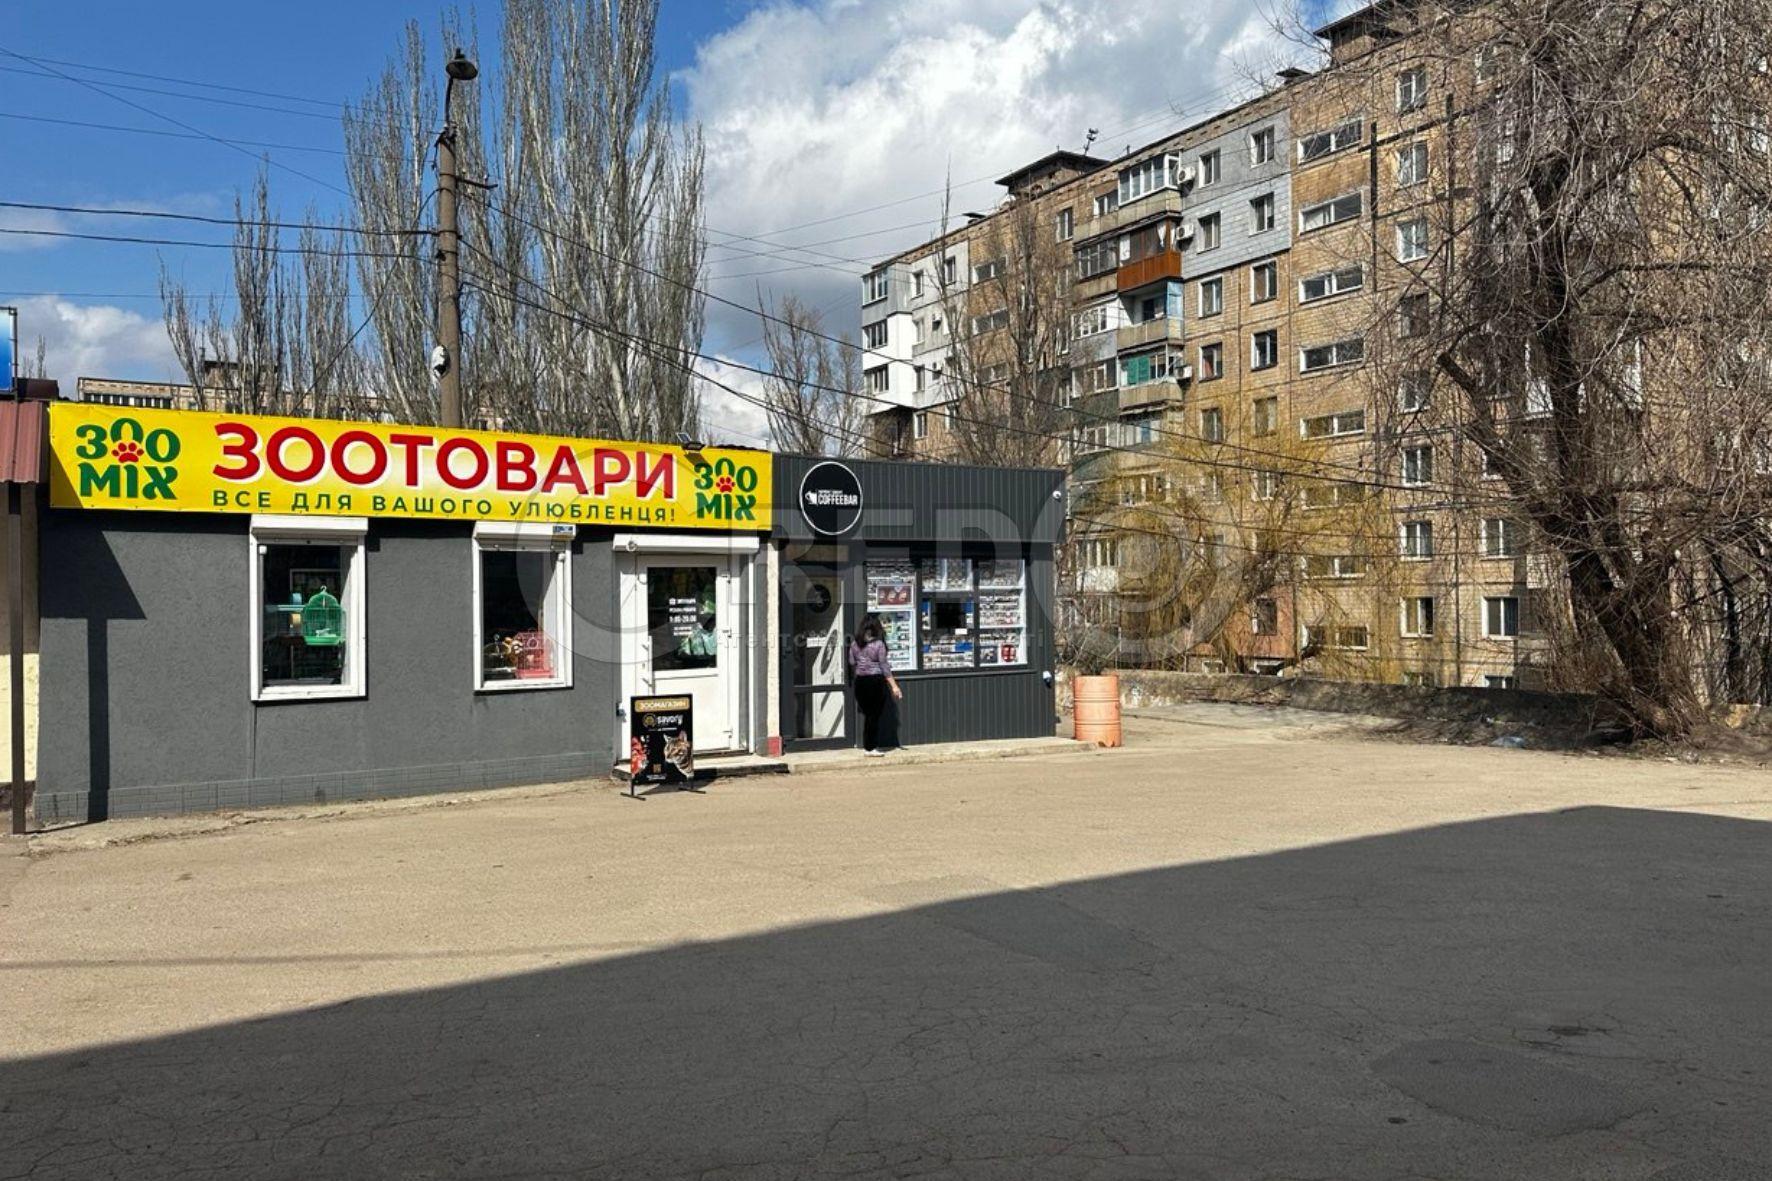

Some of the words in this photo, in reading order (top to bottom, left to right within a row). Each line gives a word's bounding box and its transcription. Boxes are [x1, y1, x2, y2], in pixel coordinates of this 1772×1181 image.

[213, 422, 673, 499] ЗООТОВАРИ
[213, 490, 271, 507] ВСЕ
[291, 493, 352, 511] ДЛЯ
[372, 496, 492, 515] ВАШОГО
[510, 501, 675, 523] УЛЮБЛЕНЦЯ!
[817, 494, 858, 506] COFFEEBAR
